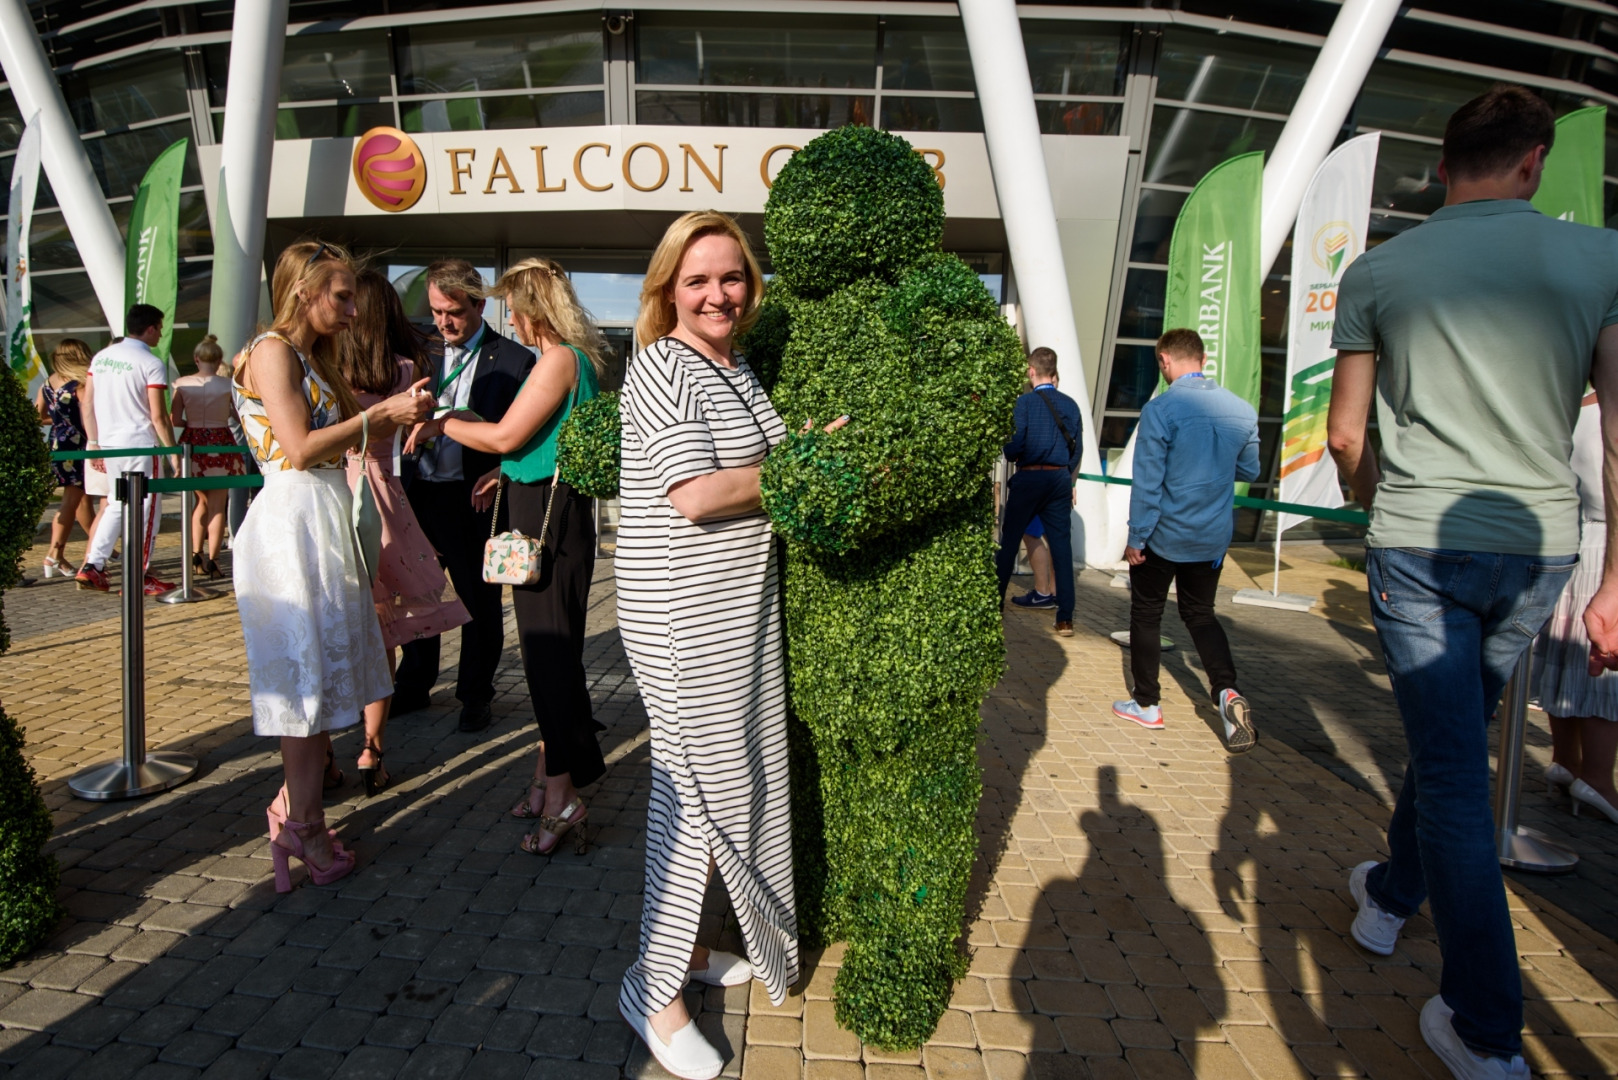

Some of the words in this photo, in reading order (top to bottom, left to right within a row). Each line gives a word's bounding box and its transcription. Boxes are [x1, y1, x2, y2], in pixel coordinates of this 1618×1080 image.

[444, 141, 729, 195] FALCON
[1198, 241, 1225, 381] BERBANK
[1305, 290, 1337, 313] 20
